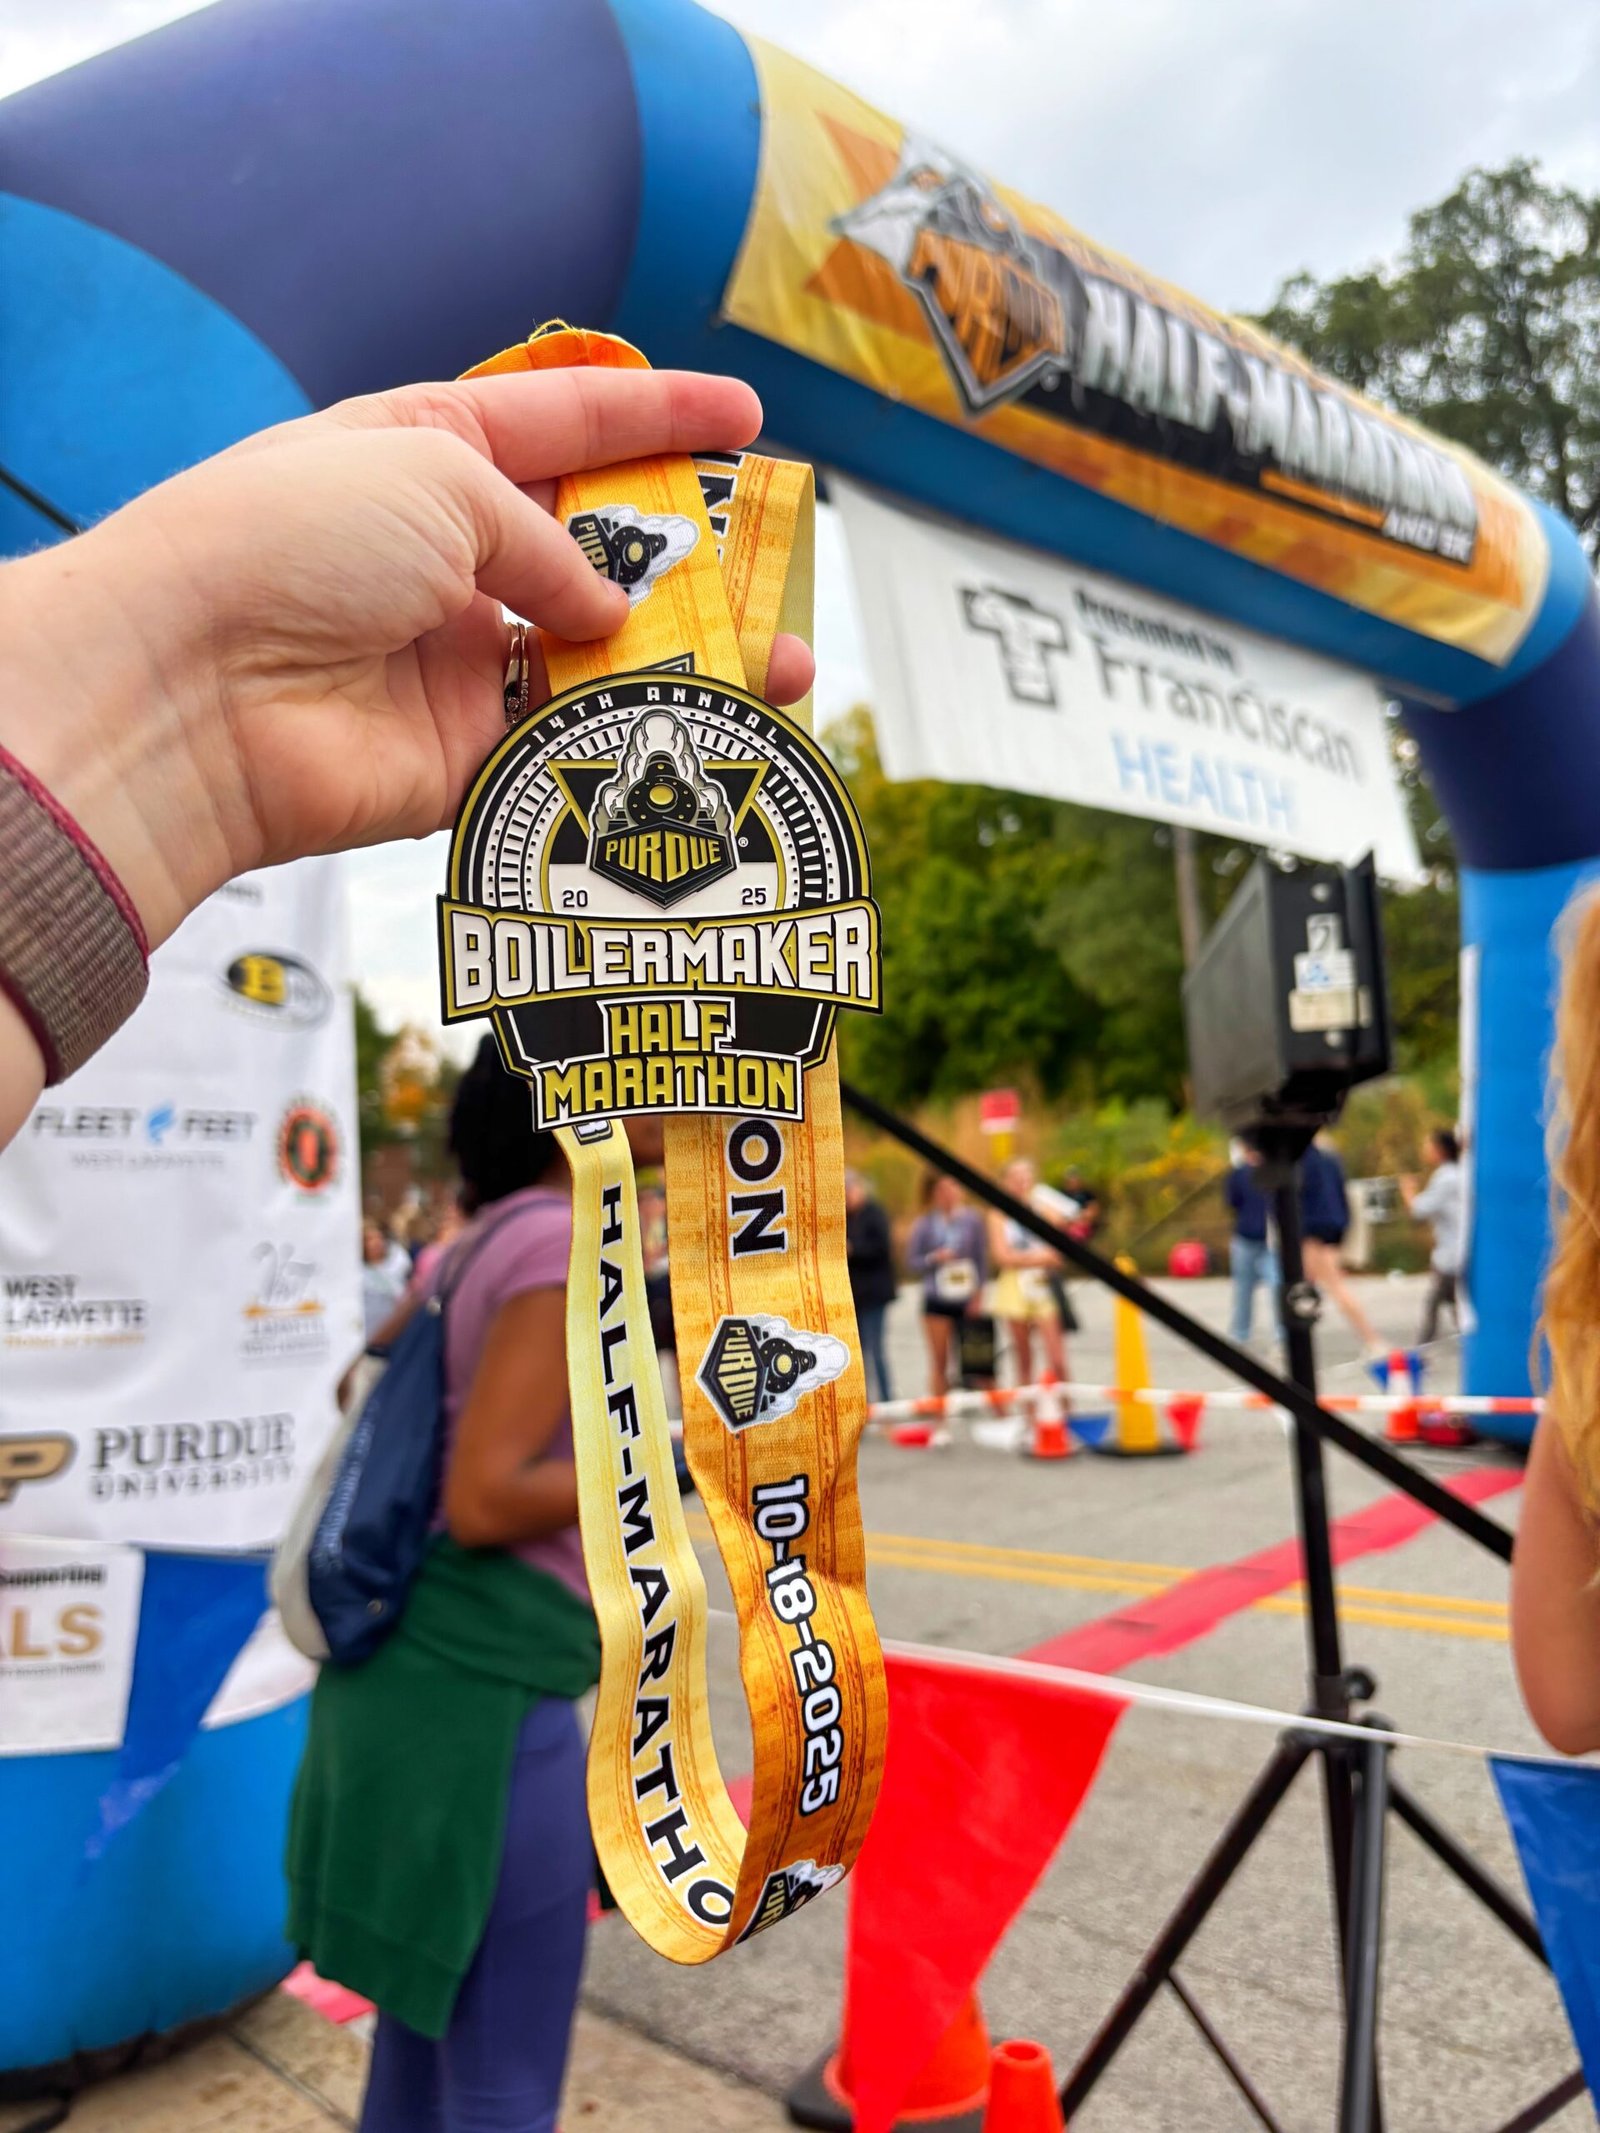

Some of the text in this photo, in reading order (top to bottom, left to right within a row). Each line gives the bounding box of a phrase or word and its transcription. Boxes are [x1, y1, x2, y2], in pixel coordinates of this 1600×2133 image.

[532, 685, 778, 744] 14TH ANNUAL
[1092, 633, 1368, 782] Franciscan
[1109, 732, 1297, 832] HEALTH
[604, 829, 723, 884] PURDUE
[561, 889, 589, 909] 20
[741, 887, 767, 907] 25
[450, 905, 873, 1009] BOILERMAKER
[609, 1002, 731, 1055] HALF
[541, 1056, 798, 1121] MARATHON
[33, 1105, 258, 1143] FLEET FEET
[5, 1273, 77, 1300] WEST
[3, 1300, 147, 1331] LAFAYETTE
[716, 1325, 758, 1420] PURDUE
[92, 1413, 296, 1472] PURDUE
[92, 1457, 292, 1503] UNIVERSITY
[752, 1474, 847, 1818] 10-18-2025
